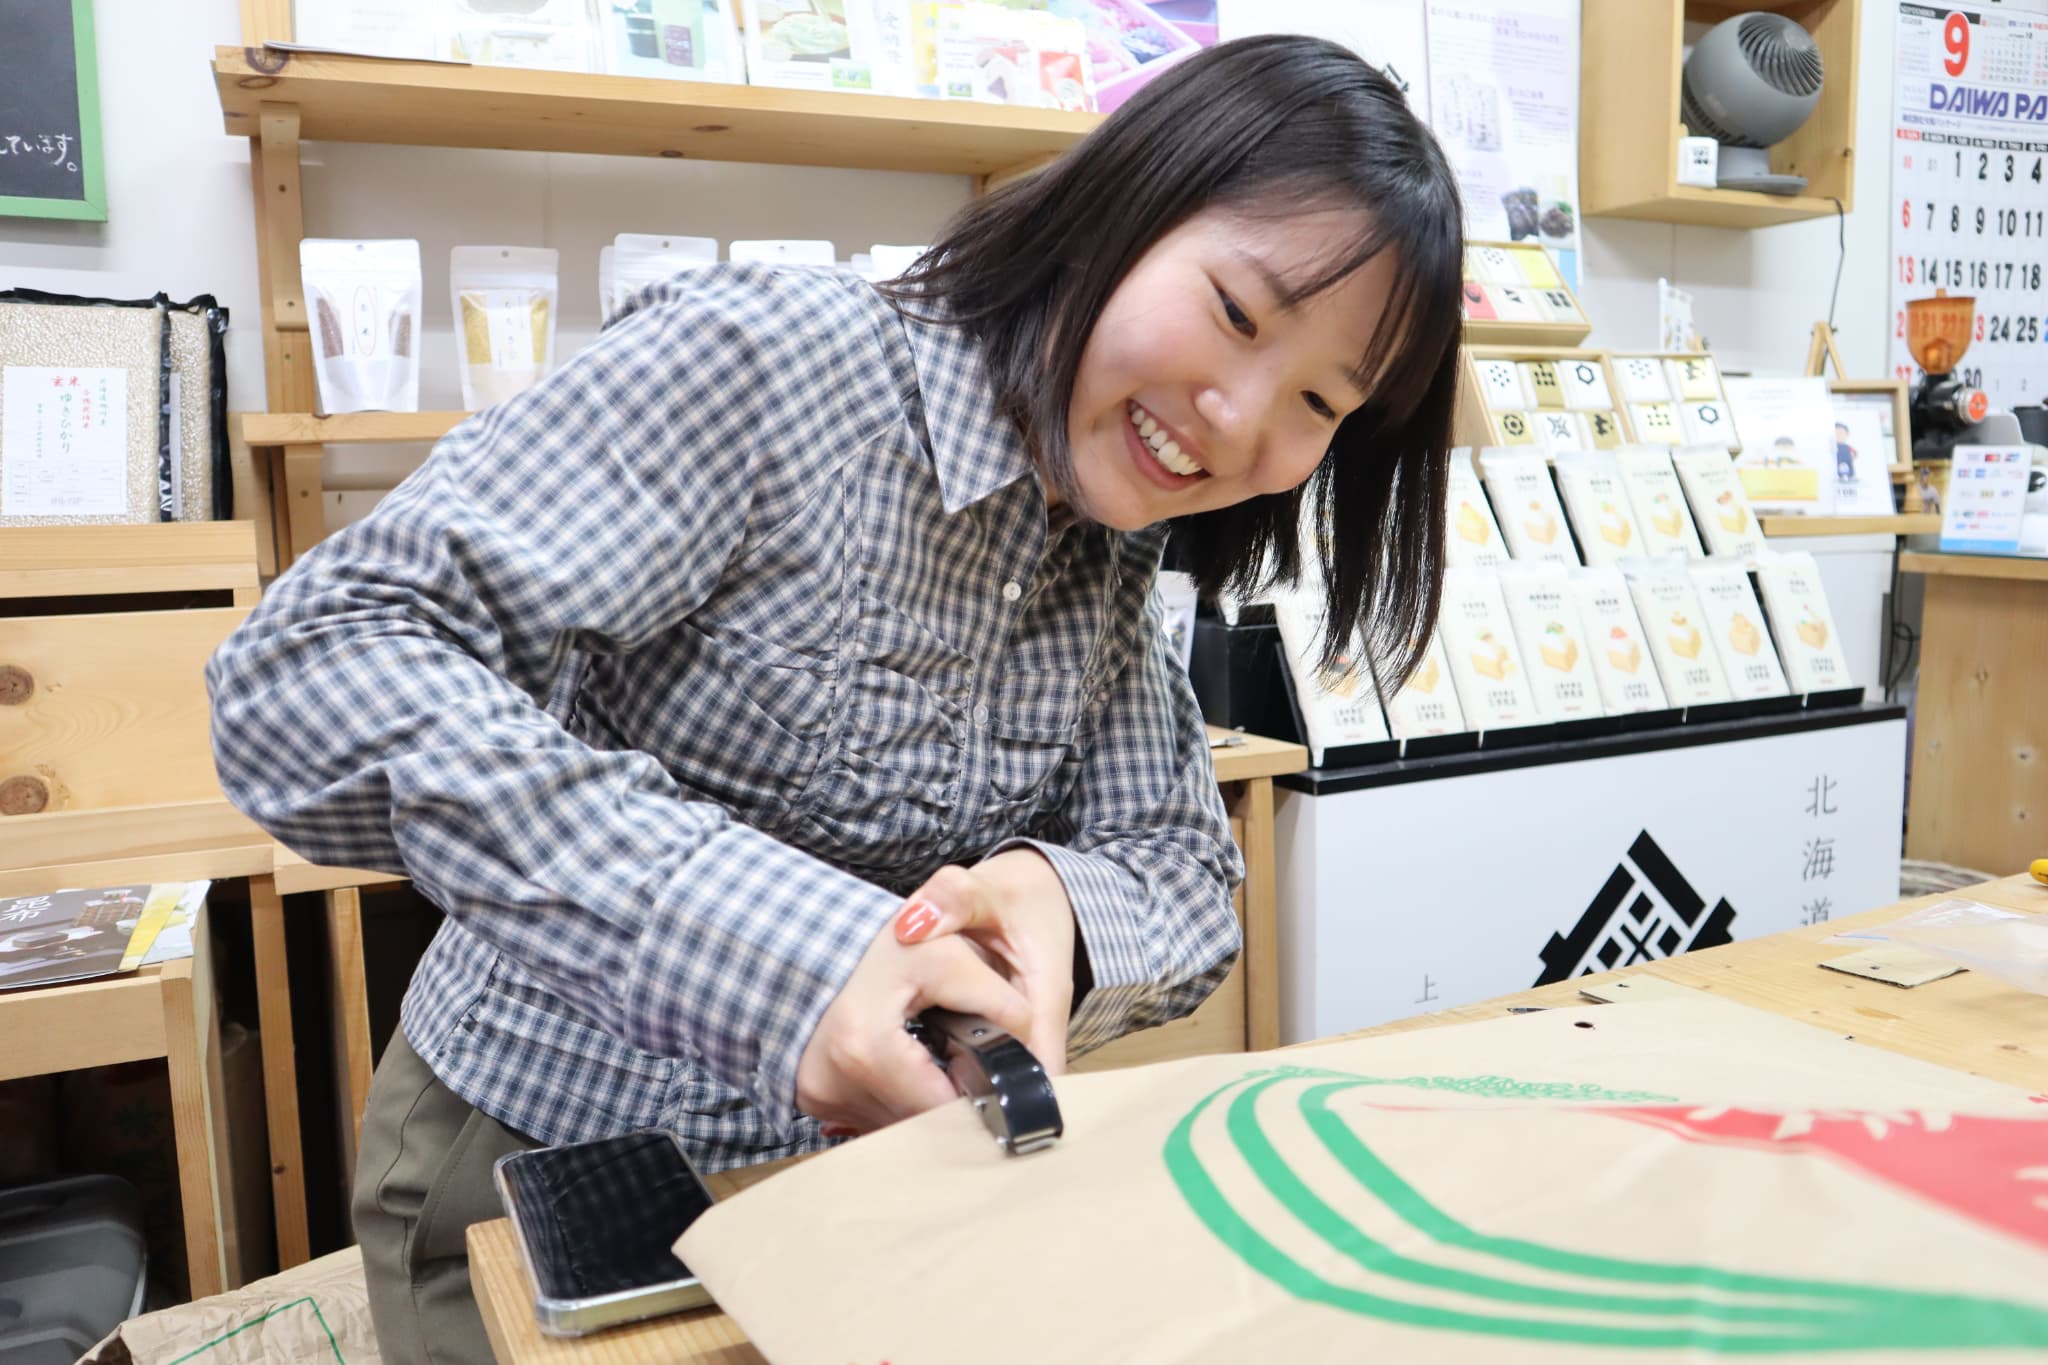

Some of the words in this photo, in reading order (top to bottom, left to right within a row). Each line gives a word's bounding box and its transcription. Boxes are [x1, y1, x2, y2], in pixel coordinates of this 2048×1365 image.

[1944, 13, 1969, 77] 9
[1929, 83, 2009, 118] DAIWA
[0, 133, 78, 172] ています。
[1956, 151, 1961, 177] 1
[1978, 152, 1988, 180] 2
[2005, 154, 2014, 183] 3
[2031, 156, 2042, 184] 4
[1902, 199, 1911, 229] 6
[1927, 202, 1935, 231] 7
[1951, 204, 1960, 232] 8
[1976, 206, 1985, 234] 9
[1998, 208, 2017, 237] 10
[2025, 211, 2043, 238] 11
[1899, 255, 1914, 284] 13
[1921, 257, 1938, 285] 14
[1945, 259, 1962, 287] 15
[1970, 261, 1987, 289] 16
[1995, 263, 2013, 289] 17
[2022, 264, 2041, 290] 18
[1990, 315, 2009, 342] 24
[2016, 316, 2038, 342] 25
[0, 896, 52, 923] 昆布
[1414, 973, 1440, 1004] 上
